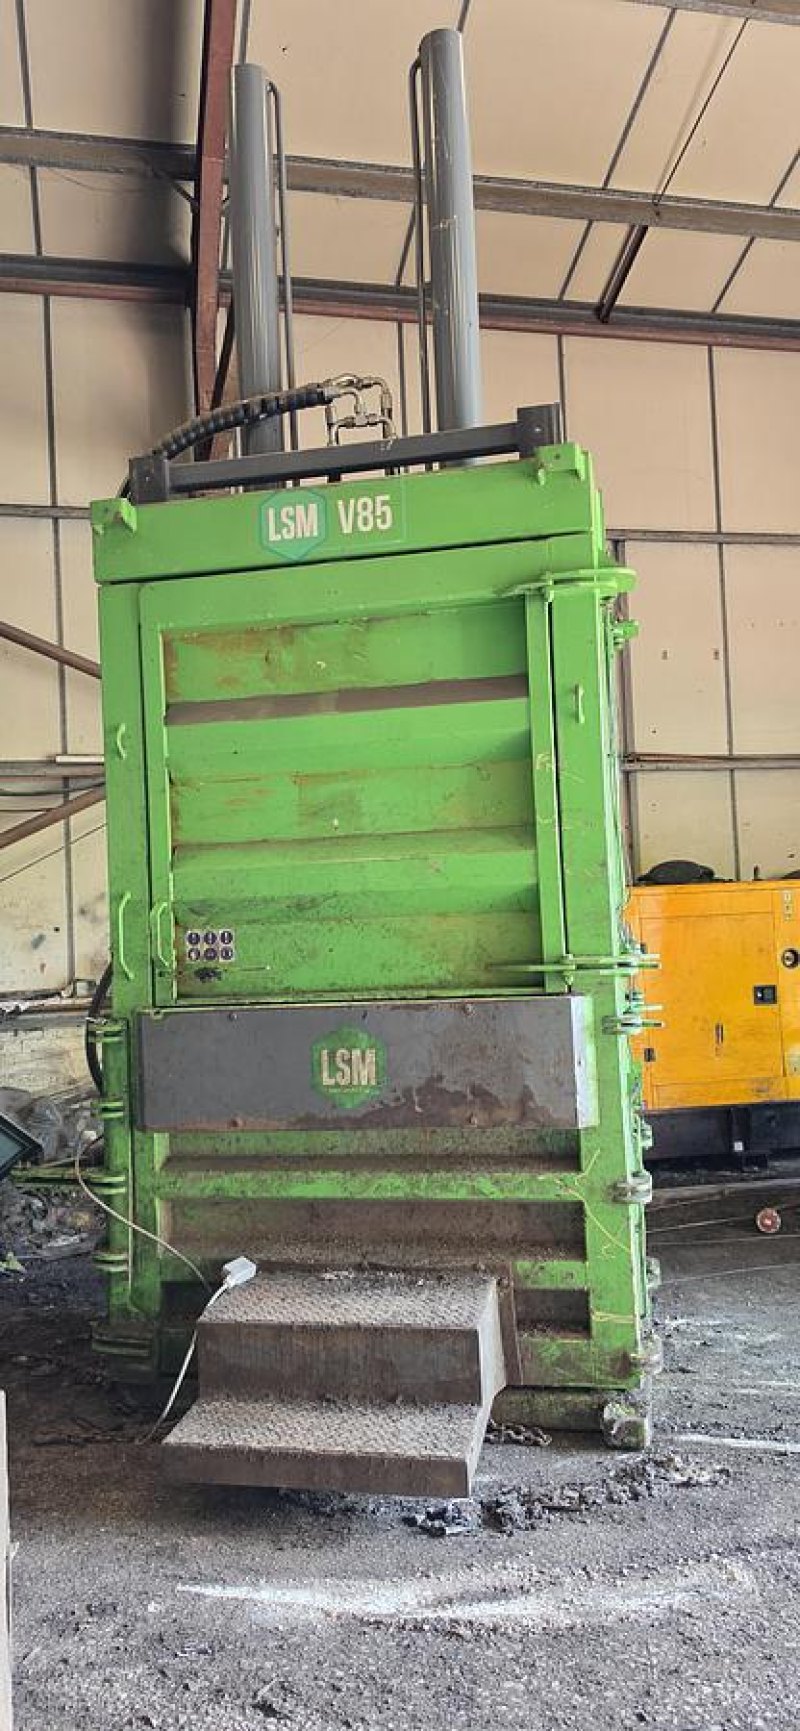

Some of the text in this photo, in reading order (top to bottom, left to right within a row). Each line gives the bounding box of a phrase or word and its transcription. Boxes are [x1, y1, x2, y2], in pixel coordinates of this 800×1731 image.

[267, 494, 394, 542] LSM V85
[321, 1049, 377, 1086] LSM
